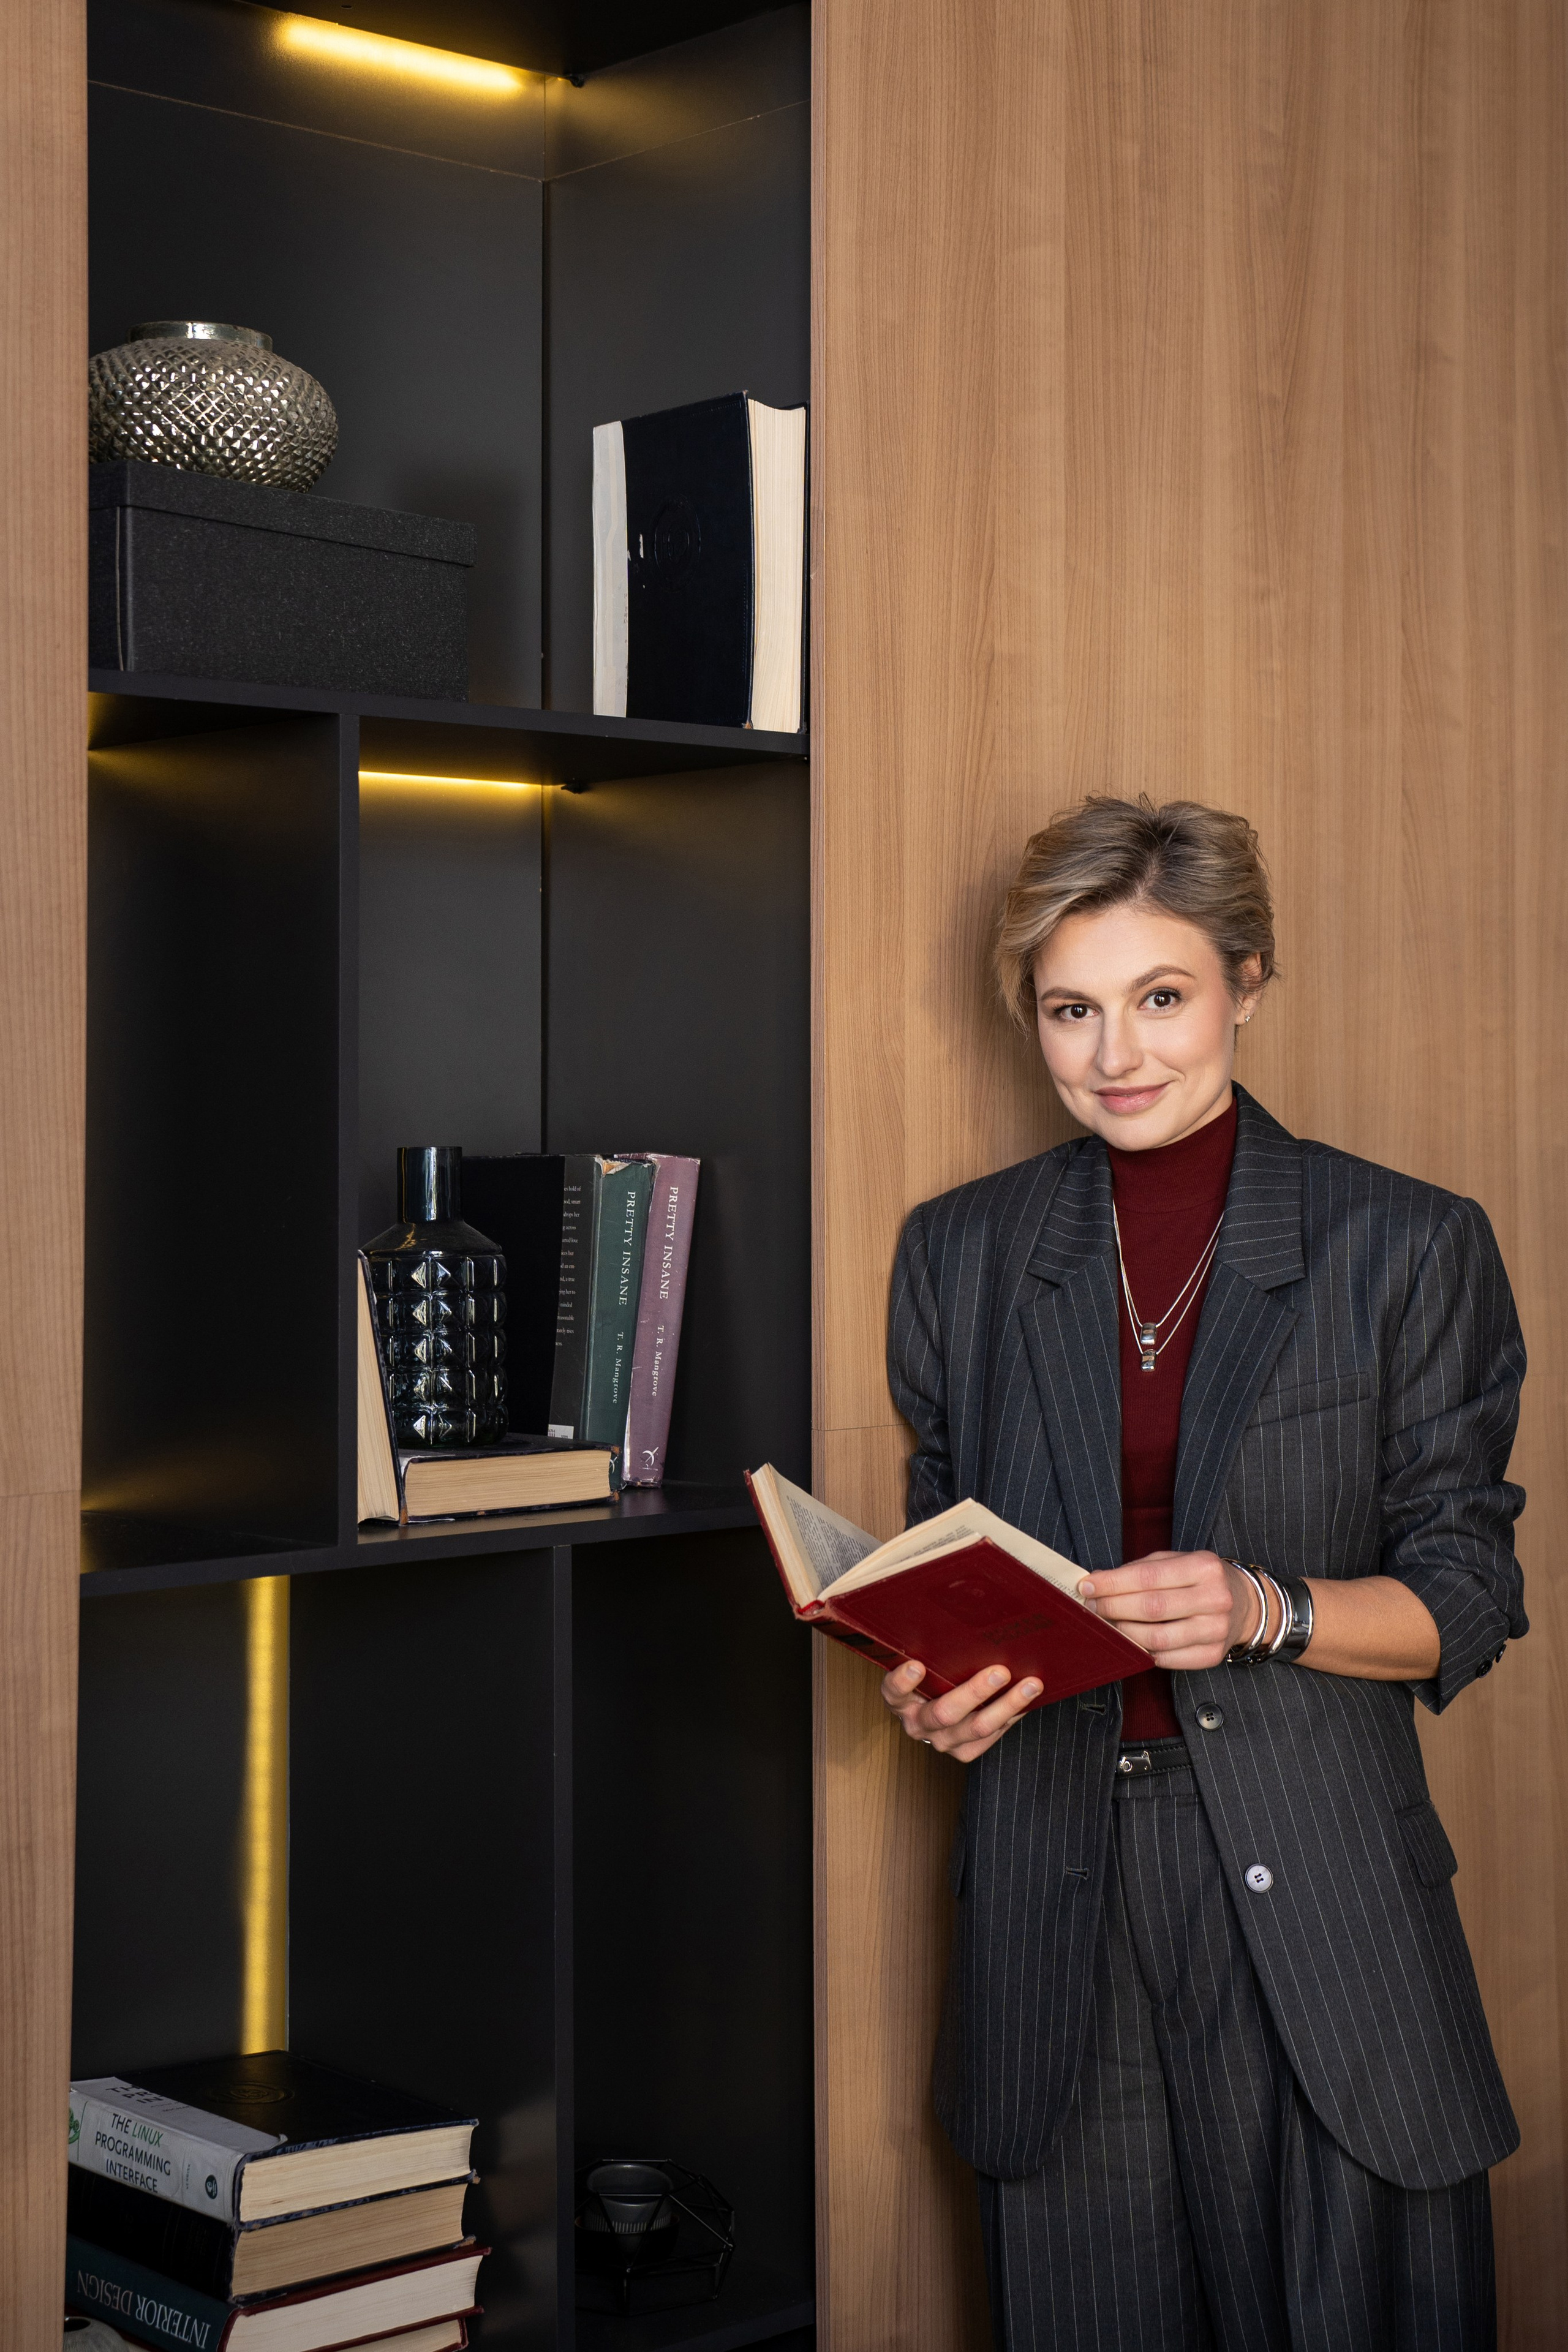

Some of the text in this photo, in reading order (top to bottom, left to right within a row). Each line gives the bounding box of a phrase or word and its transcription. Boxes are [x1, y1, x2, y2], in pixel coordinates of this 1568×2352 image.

[619, 1191, 636, 1305] PRETTY INSANE
[659, 1186, 679, 1299] PRETTY INSANE
[612, 1332, 624, 1404] T. R. Mangrove
[652, 1325, 665, 1396] T. R. Mangrove
[95, 2131, 171, 2176] PROGRAMMING
[111, 2113, 164, 2147] THE LINUX
[106, 2158, 158, 2193] INTERFACE
[77, 2269, 211, 2349] INTERIOR DESIGN
